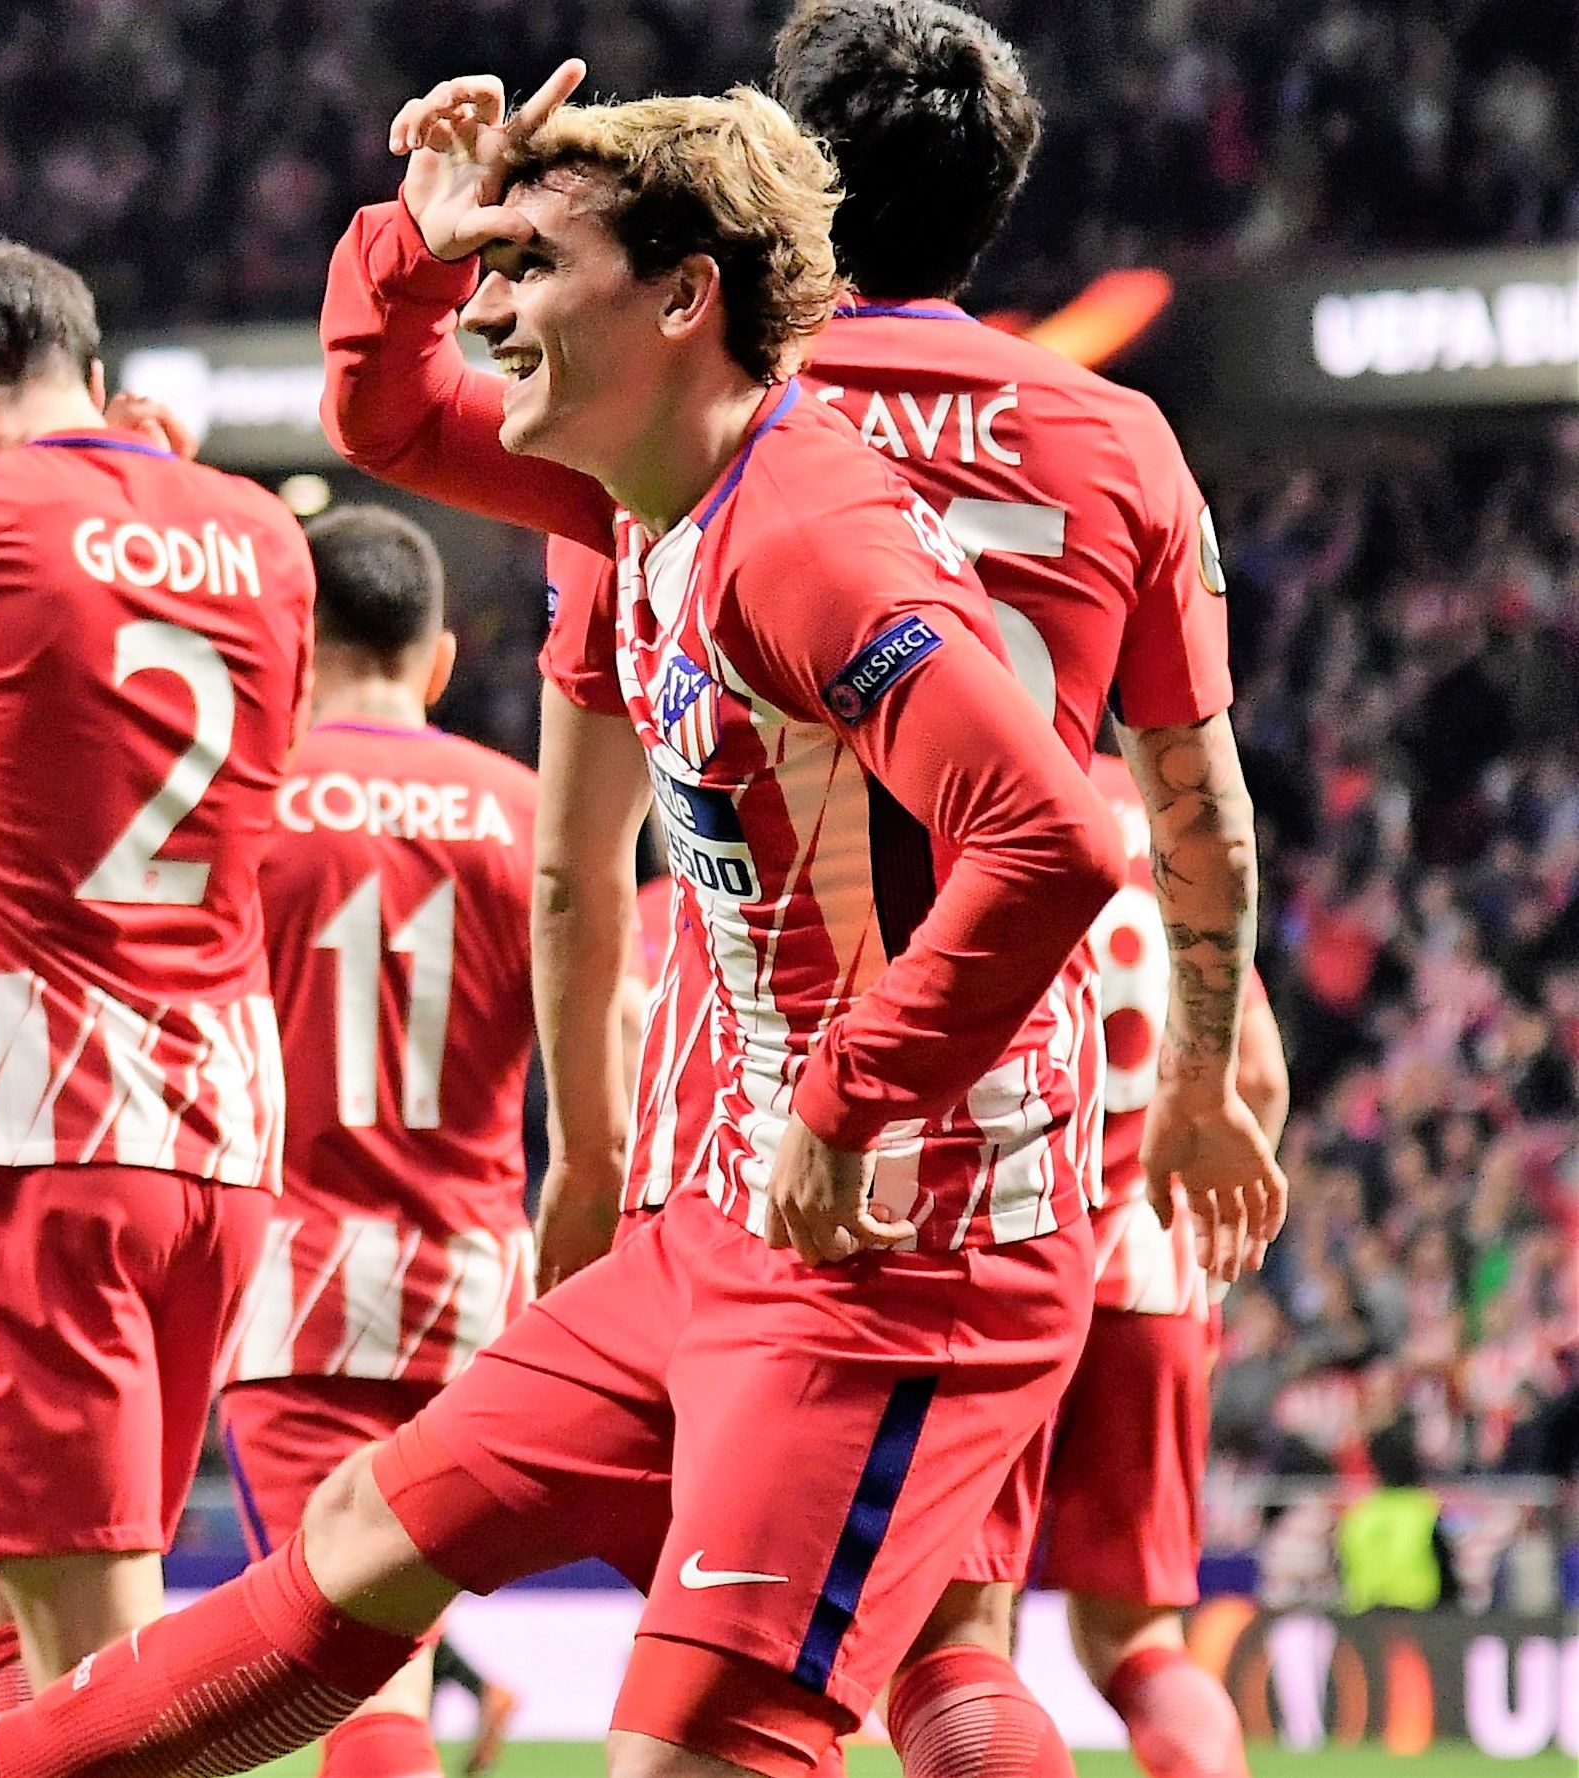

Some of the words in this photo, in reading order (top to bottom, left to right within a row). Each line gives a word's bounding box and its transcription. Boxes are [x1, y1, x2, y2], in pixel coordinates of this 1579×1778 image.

[74, 518, 260, 597] GODÍN
[852, 623, 933, 693] RESPECT
[74, 619, 236, 905] 2
[275, 772, 514, 846] CORREA
[314, 869, 457, 1130] 11
